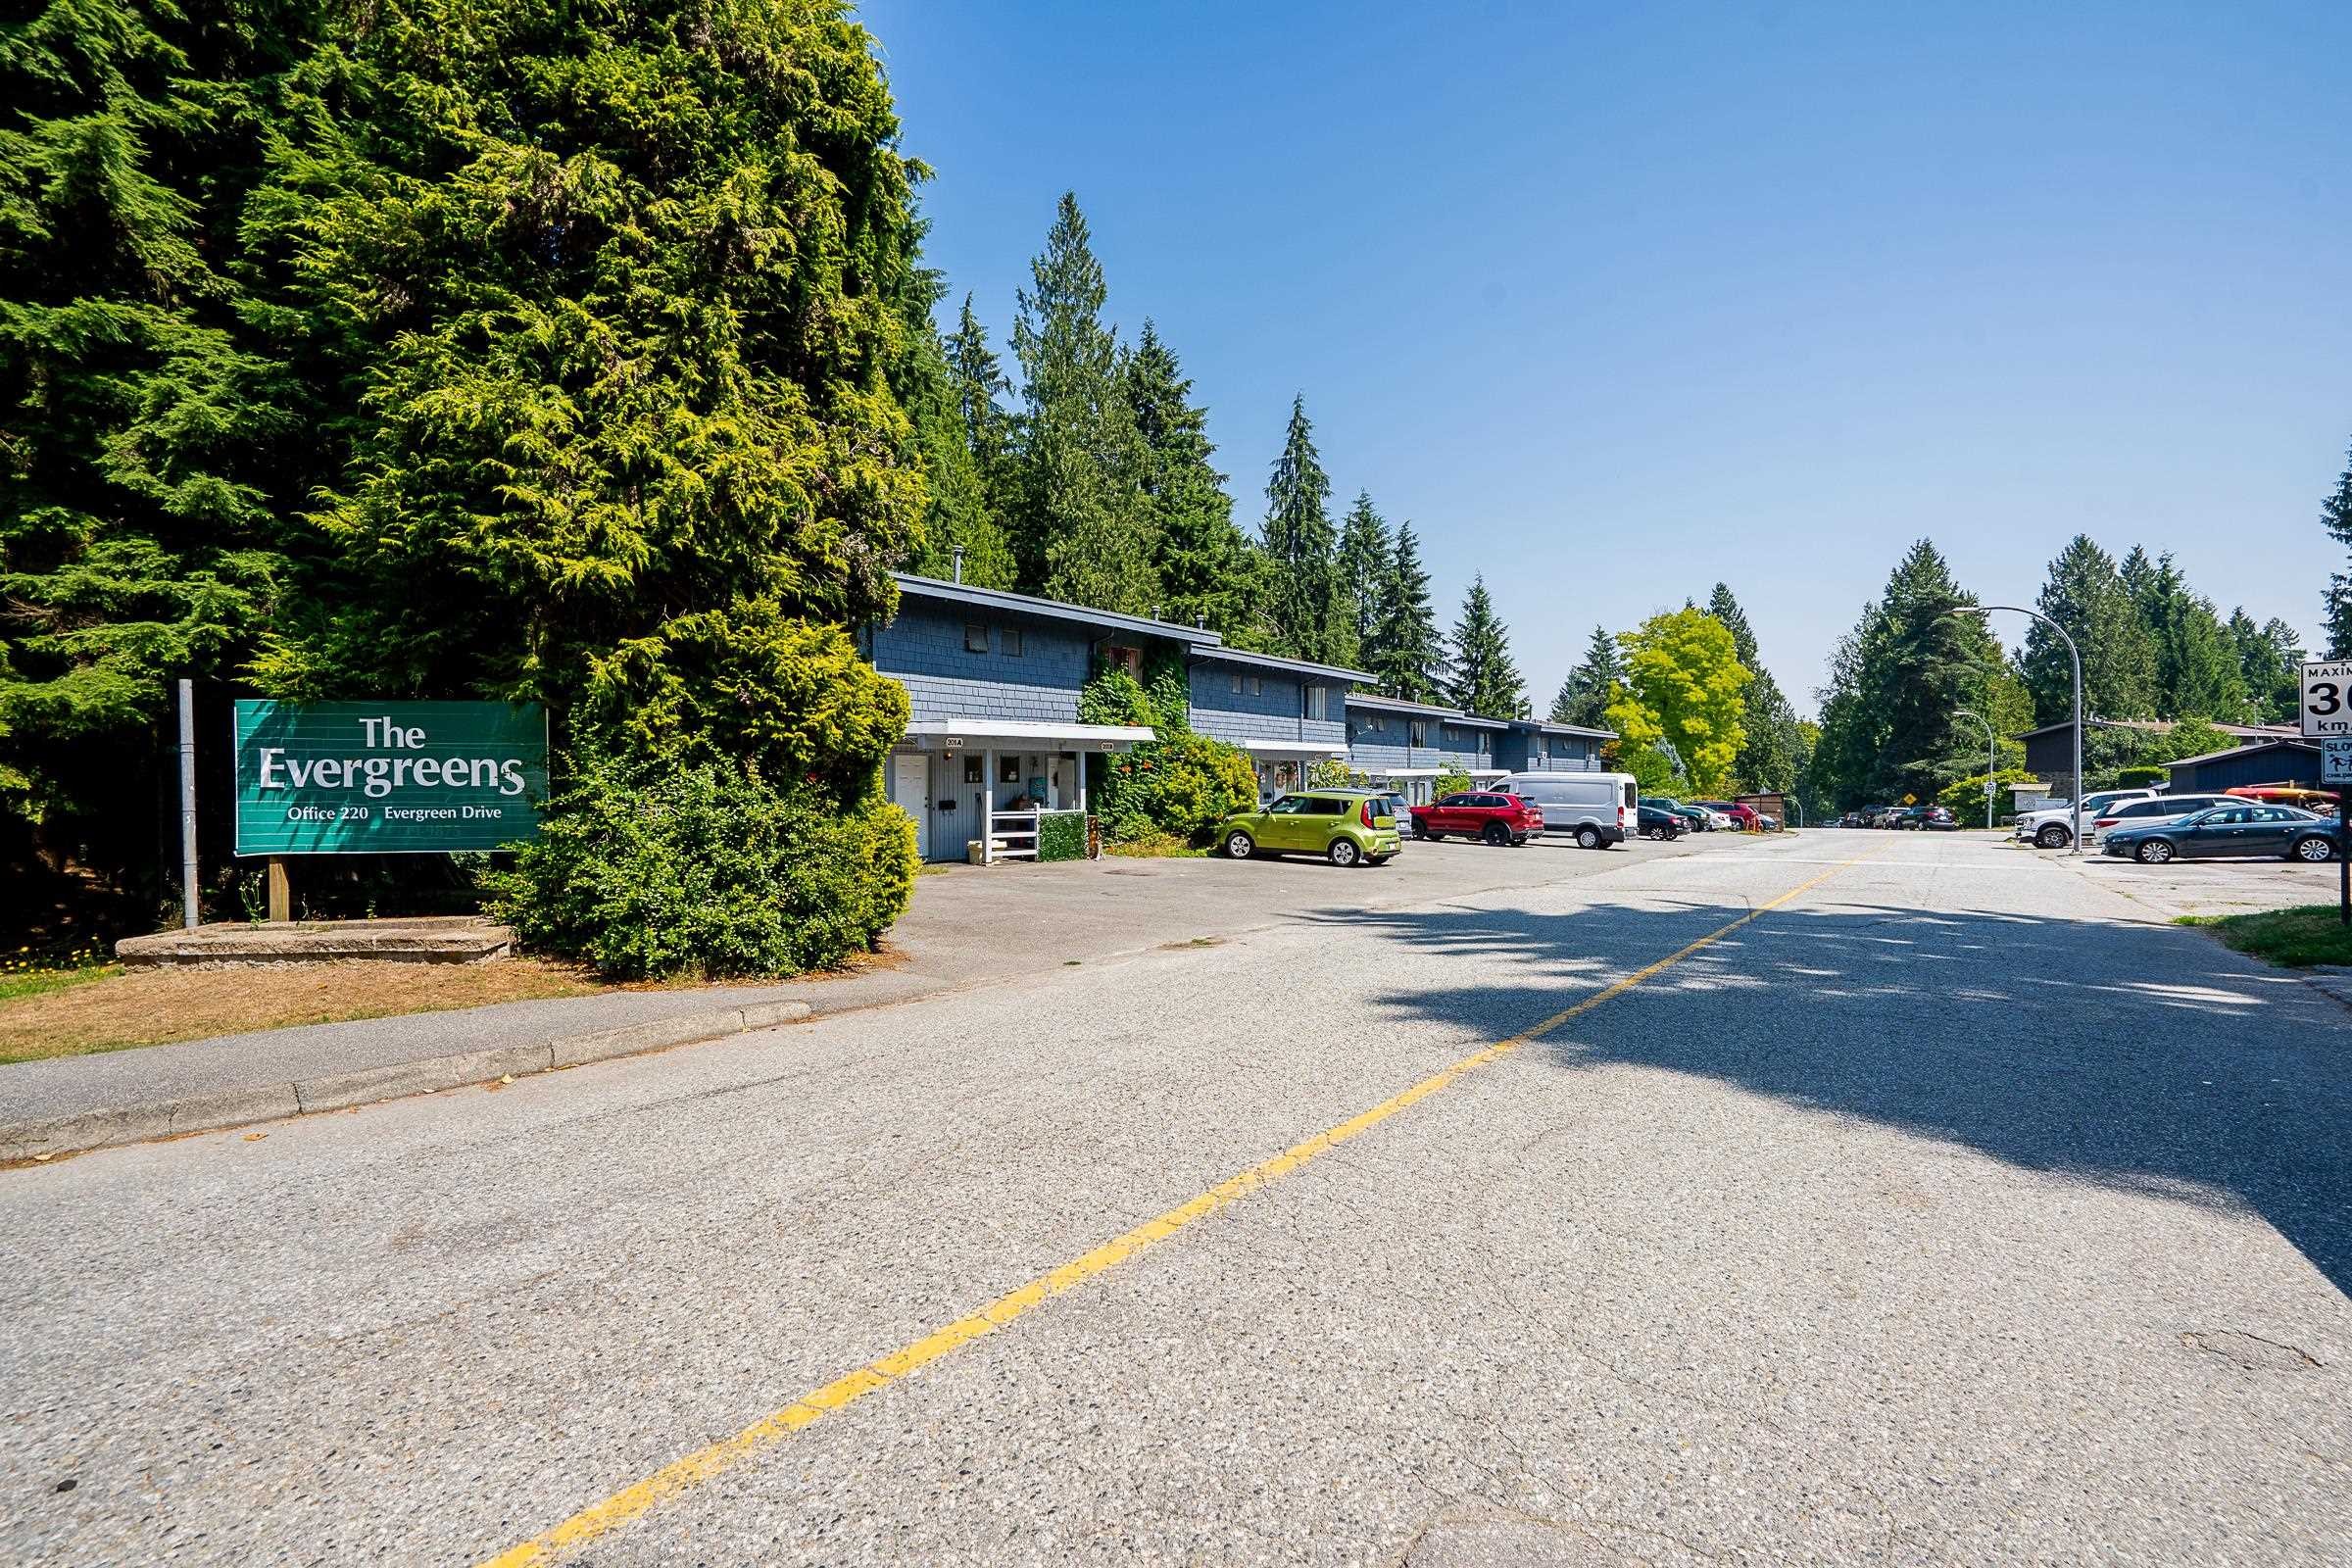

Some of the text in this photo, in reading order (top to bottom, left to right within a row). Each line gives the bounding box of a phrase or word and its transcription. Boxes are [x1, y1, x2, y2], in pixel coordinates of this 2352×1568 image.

[2308, 682, 2352, 715] 3
[359, 716, 425, 749] The
[2318, 720, 2352, 731] km
[2326, 742, 2352, 753] SLO
[260, 748, 525, 797] Evergreens
[287, 805, 503, 822] Office 220 Evergreen Drive
